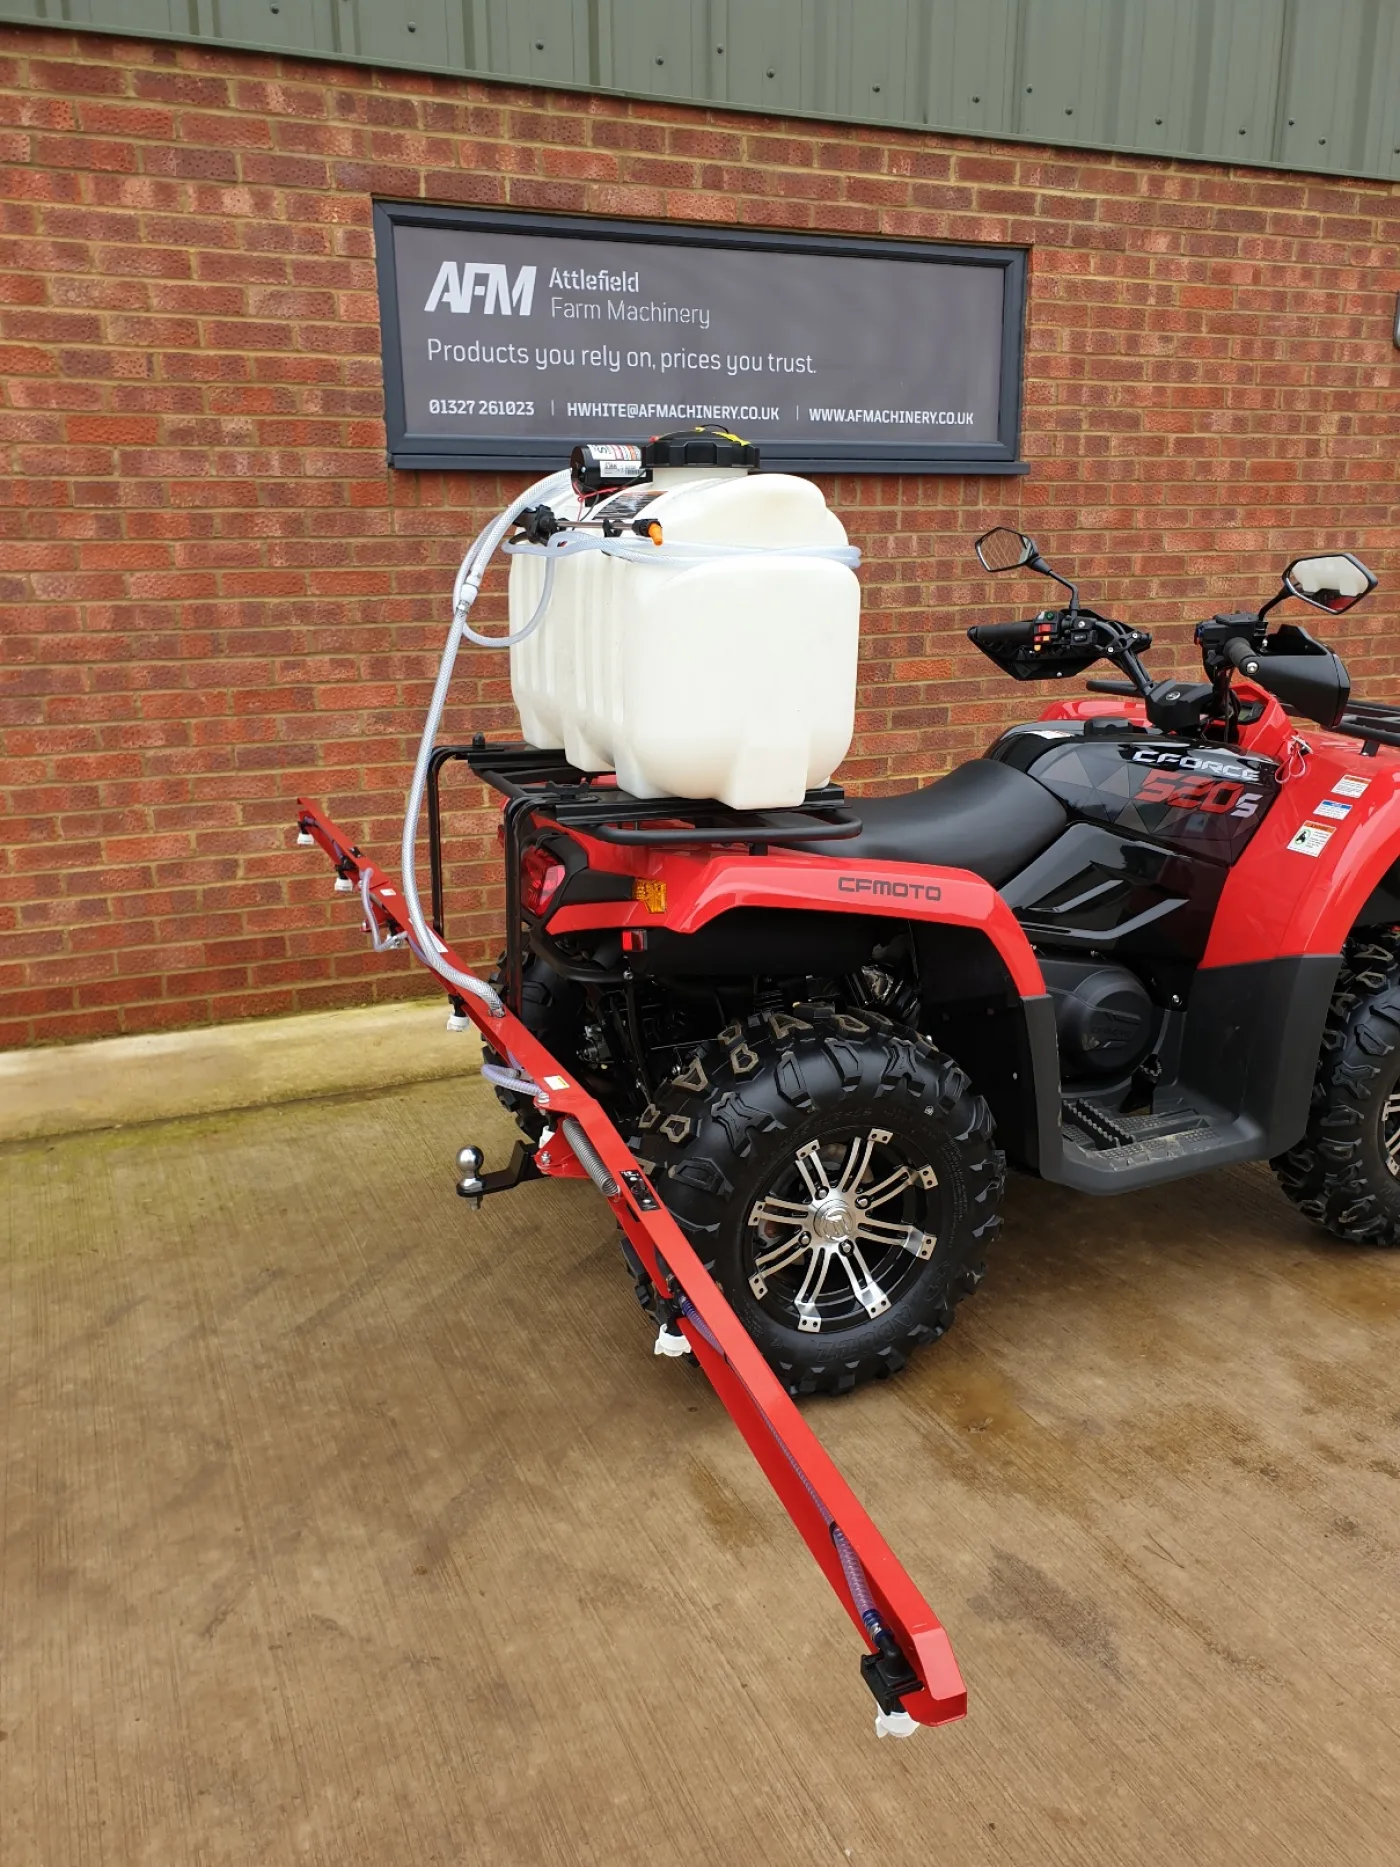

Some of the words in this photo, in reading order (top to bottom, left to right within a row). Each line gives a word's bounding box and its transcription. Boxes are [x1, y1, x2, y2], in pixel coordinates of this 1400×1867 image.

[424, 261, 537, 316] AFM
[549, 267, 639, 292] Attlefield
[551, 297, 601, 319] Farm
[607, 299, 710, 329] Machinery
[427, 338, 529, 364] Products
[535, 348, 575, 370] you
[581, 344, 620, 373] rely
[627, 350, 656, 370] on,
[661, 348, 721, 373] prices
[727, 354, 763, 376] you
[768, 353, 816, 374] trust.
[429, 399, 475, 415] 01327
[478, 400, 535, 416] 261023
[567, 402, 780, 421] HWHITE@AFMACHINERY.CO.UK
[808, 408, 974, 425] WWW.AFMACHINERY.CO.UK
[1131, 750, 1260, 781] CFORCE
[837, 876, 941, 902] CFMOTO
